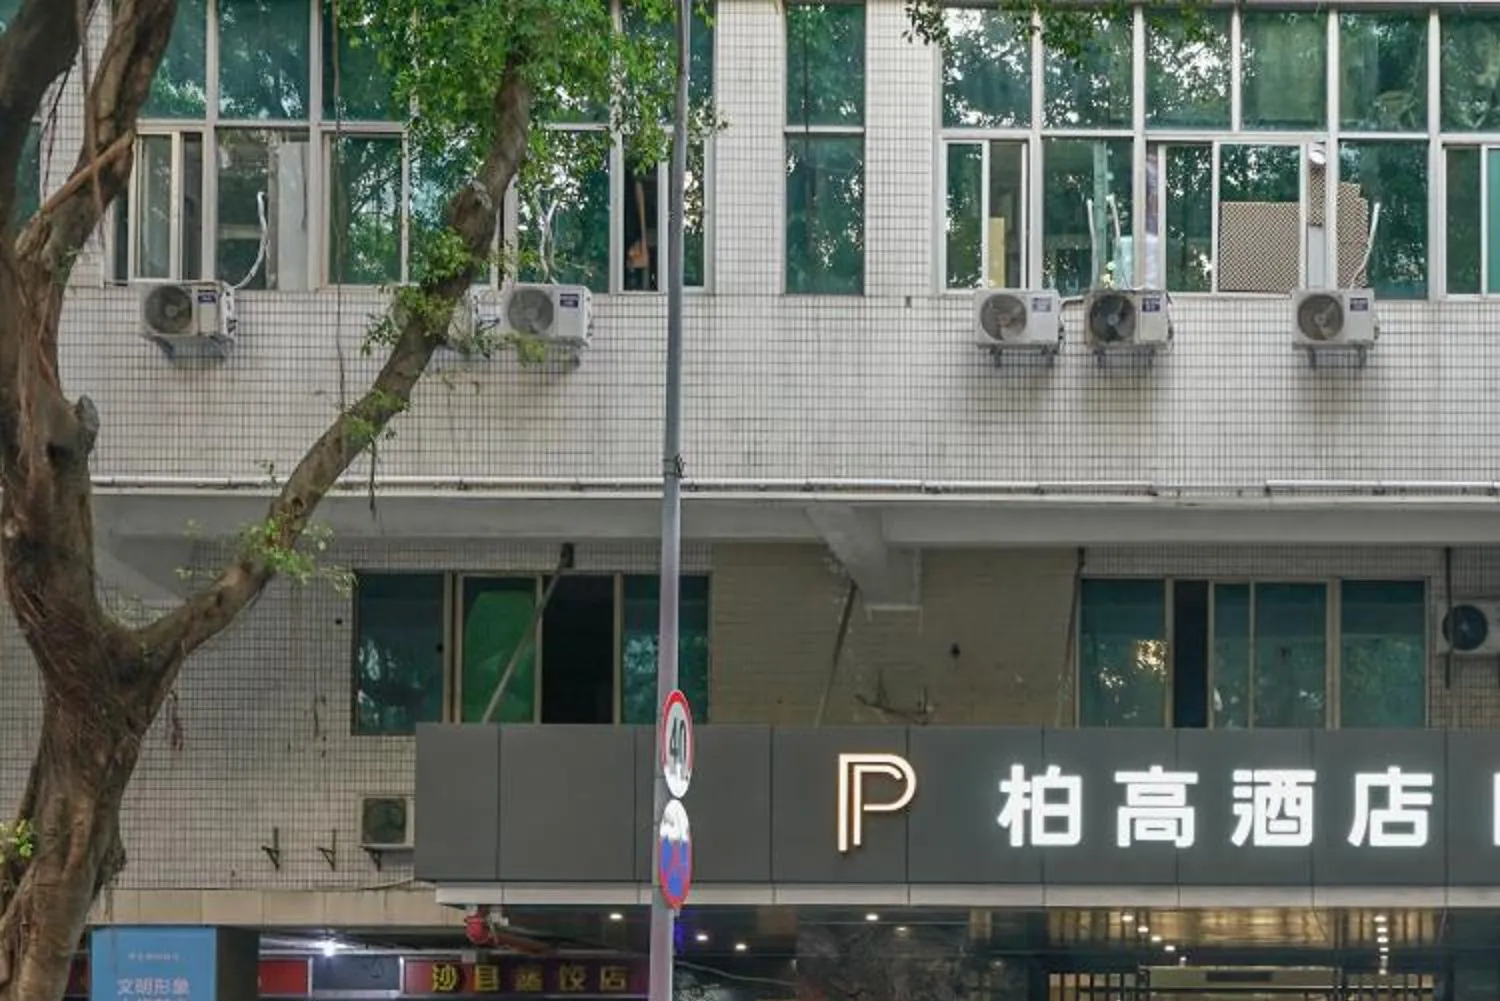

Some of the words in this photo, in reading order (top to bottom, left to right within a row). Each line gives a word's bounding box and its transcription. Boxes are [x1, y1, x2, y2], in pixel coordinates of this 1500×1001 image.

[669, 718, 688, 773] 40
[996, 764, 1434, 849] 柏高酒店
